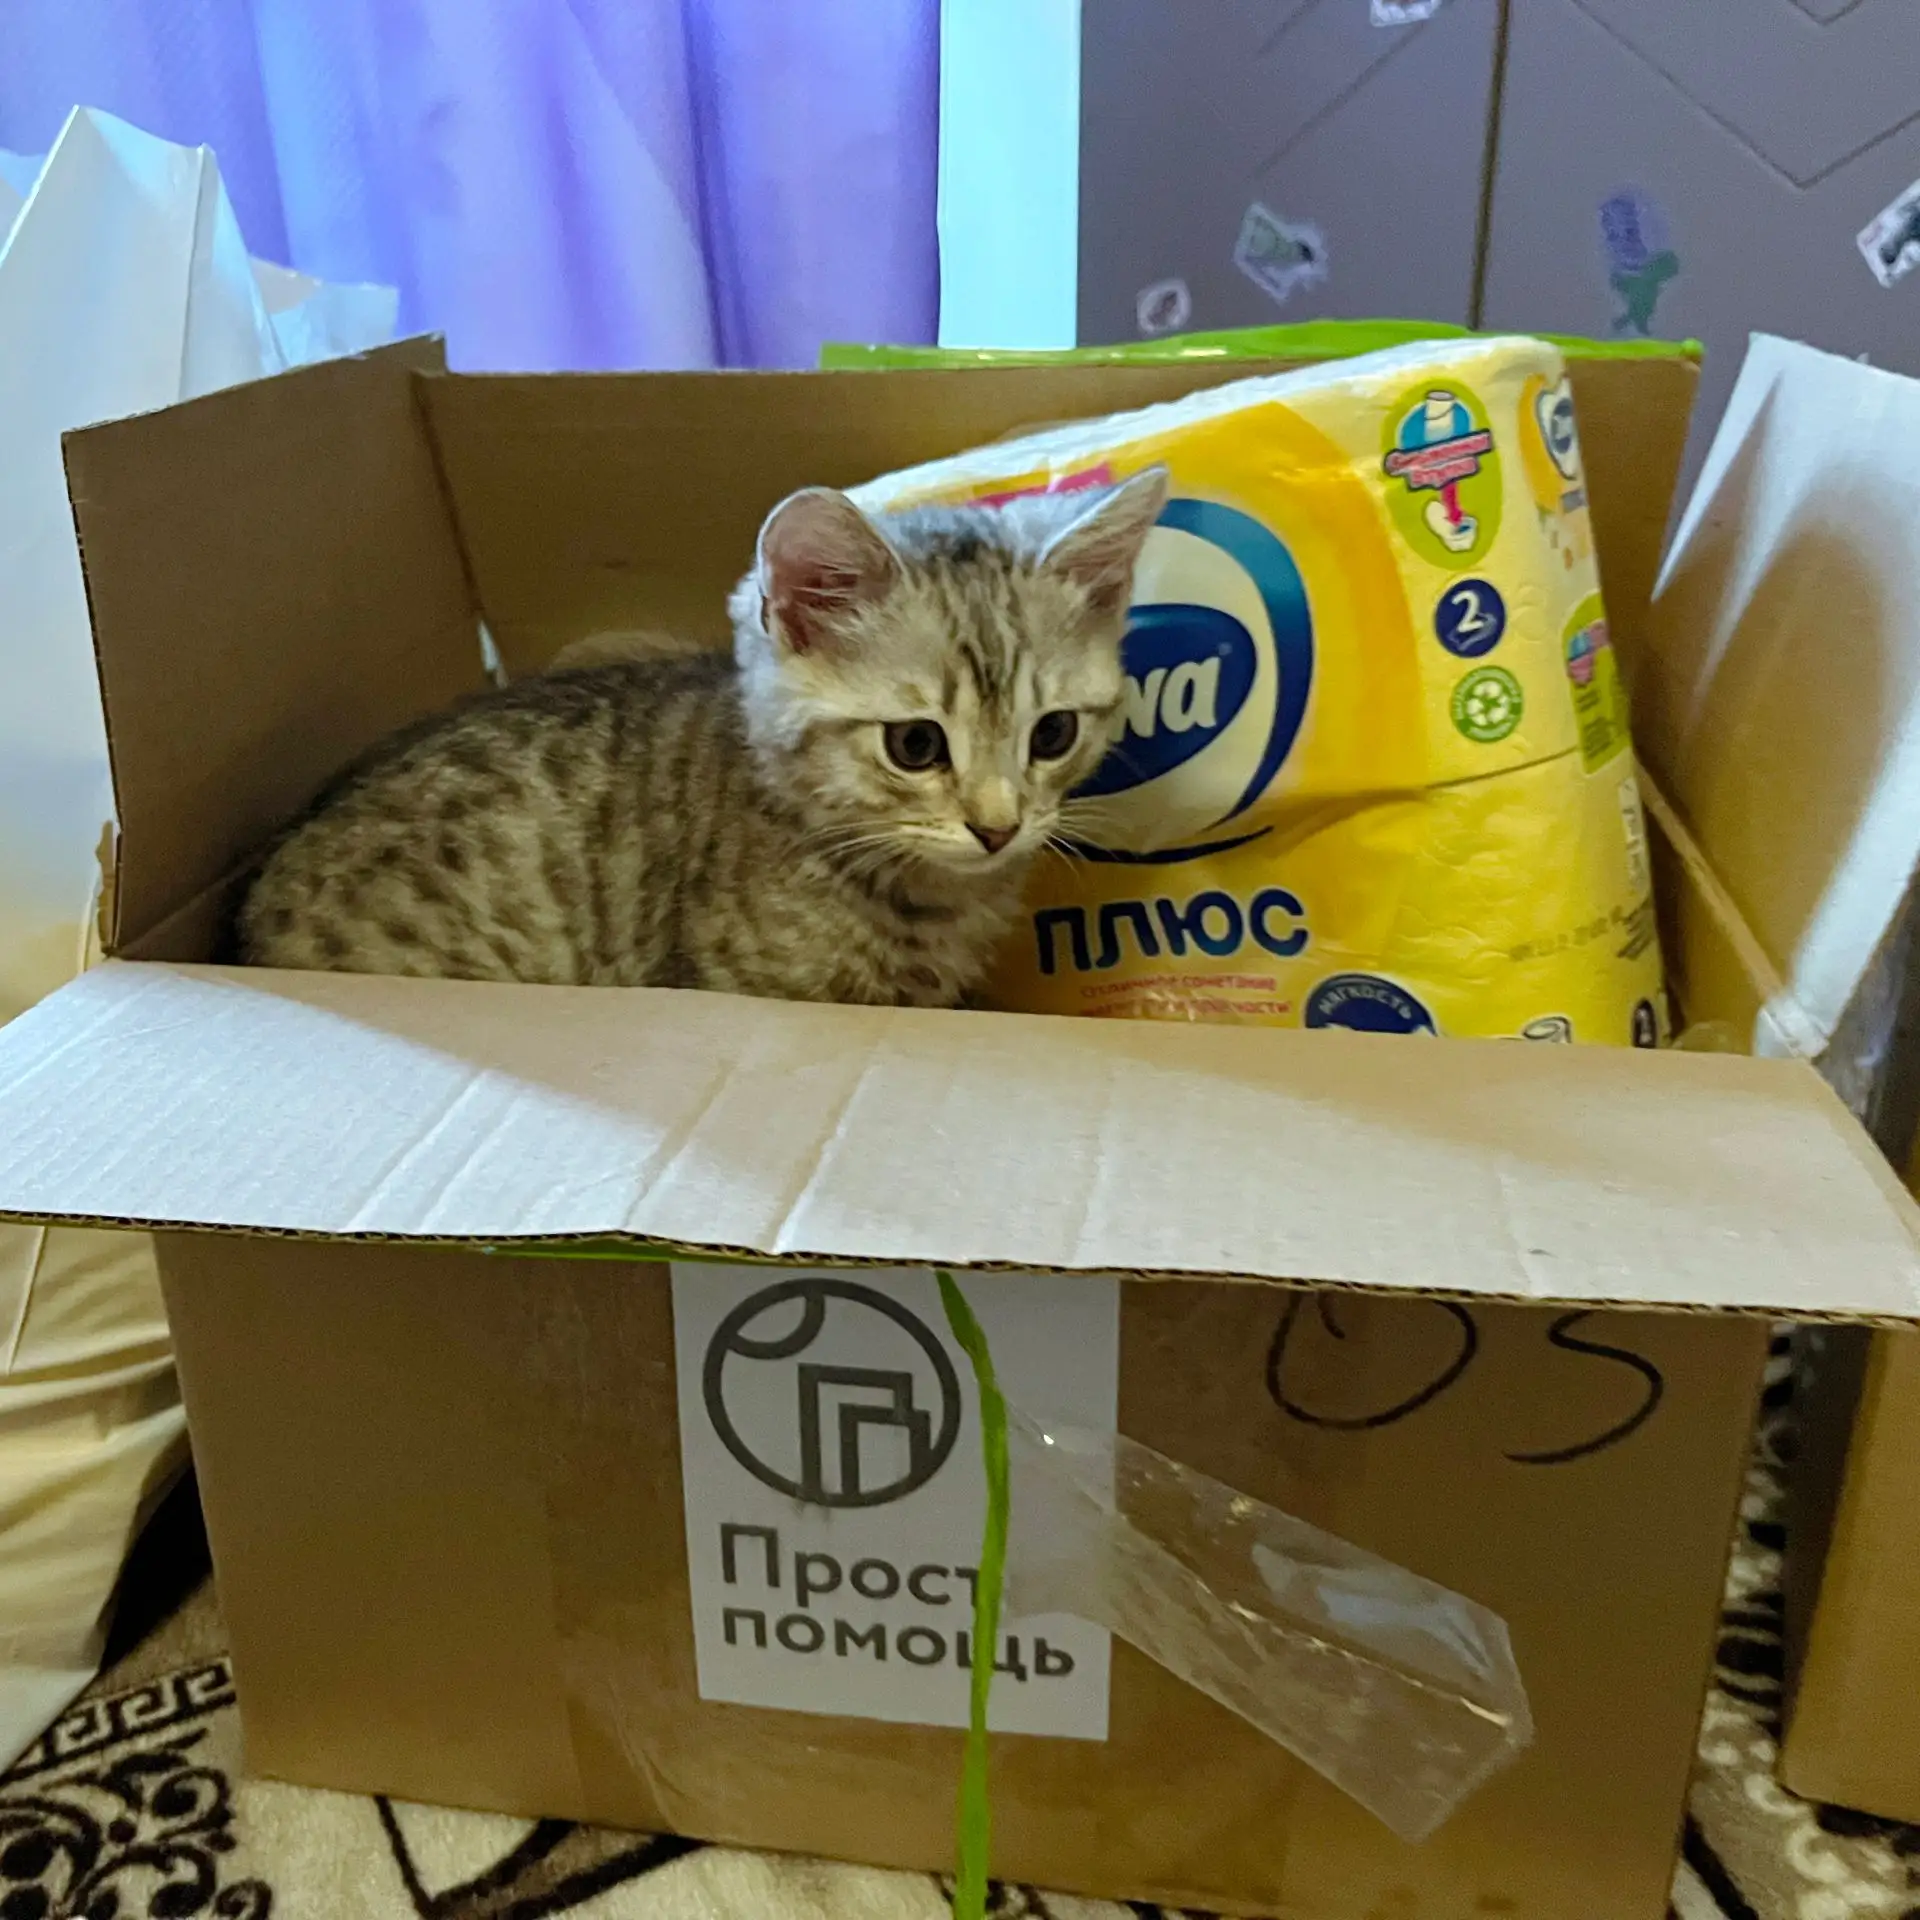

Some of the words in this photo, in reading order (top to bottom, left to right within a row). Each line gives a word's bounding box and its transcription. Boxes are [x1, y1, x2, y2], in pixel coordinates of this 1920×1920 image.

[1451, 590, 1484, 633] 2
[1108, 656, 1221, 743] wa
[1318, 984, 1413, 1021] МЯГКОСТЬ
[721, 1523, 980, 1607] Прост
[723, 1607, 1075, 1682] помощь
